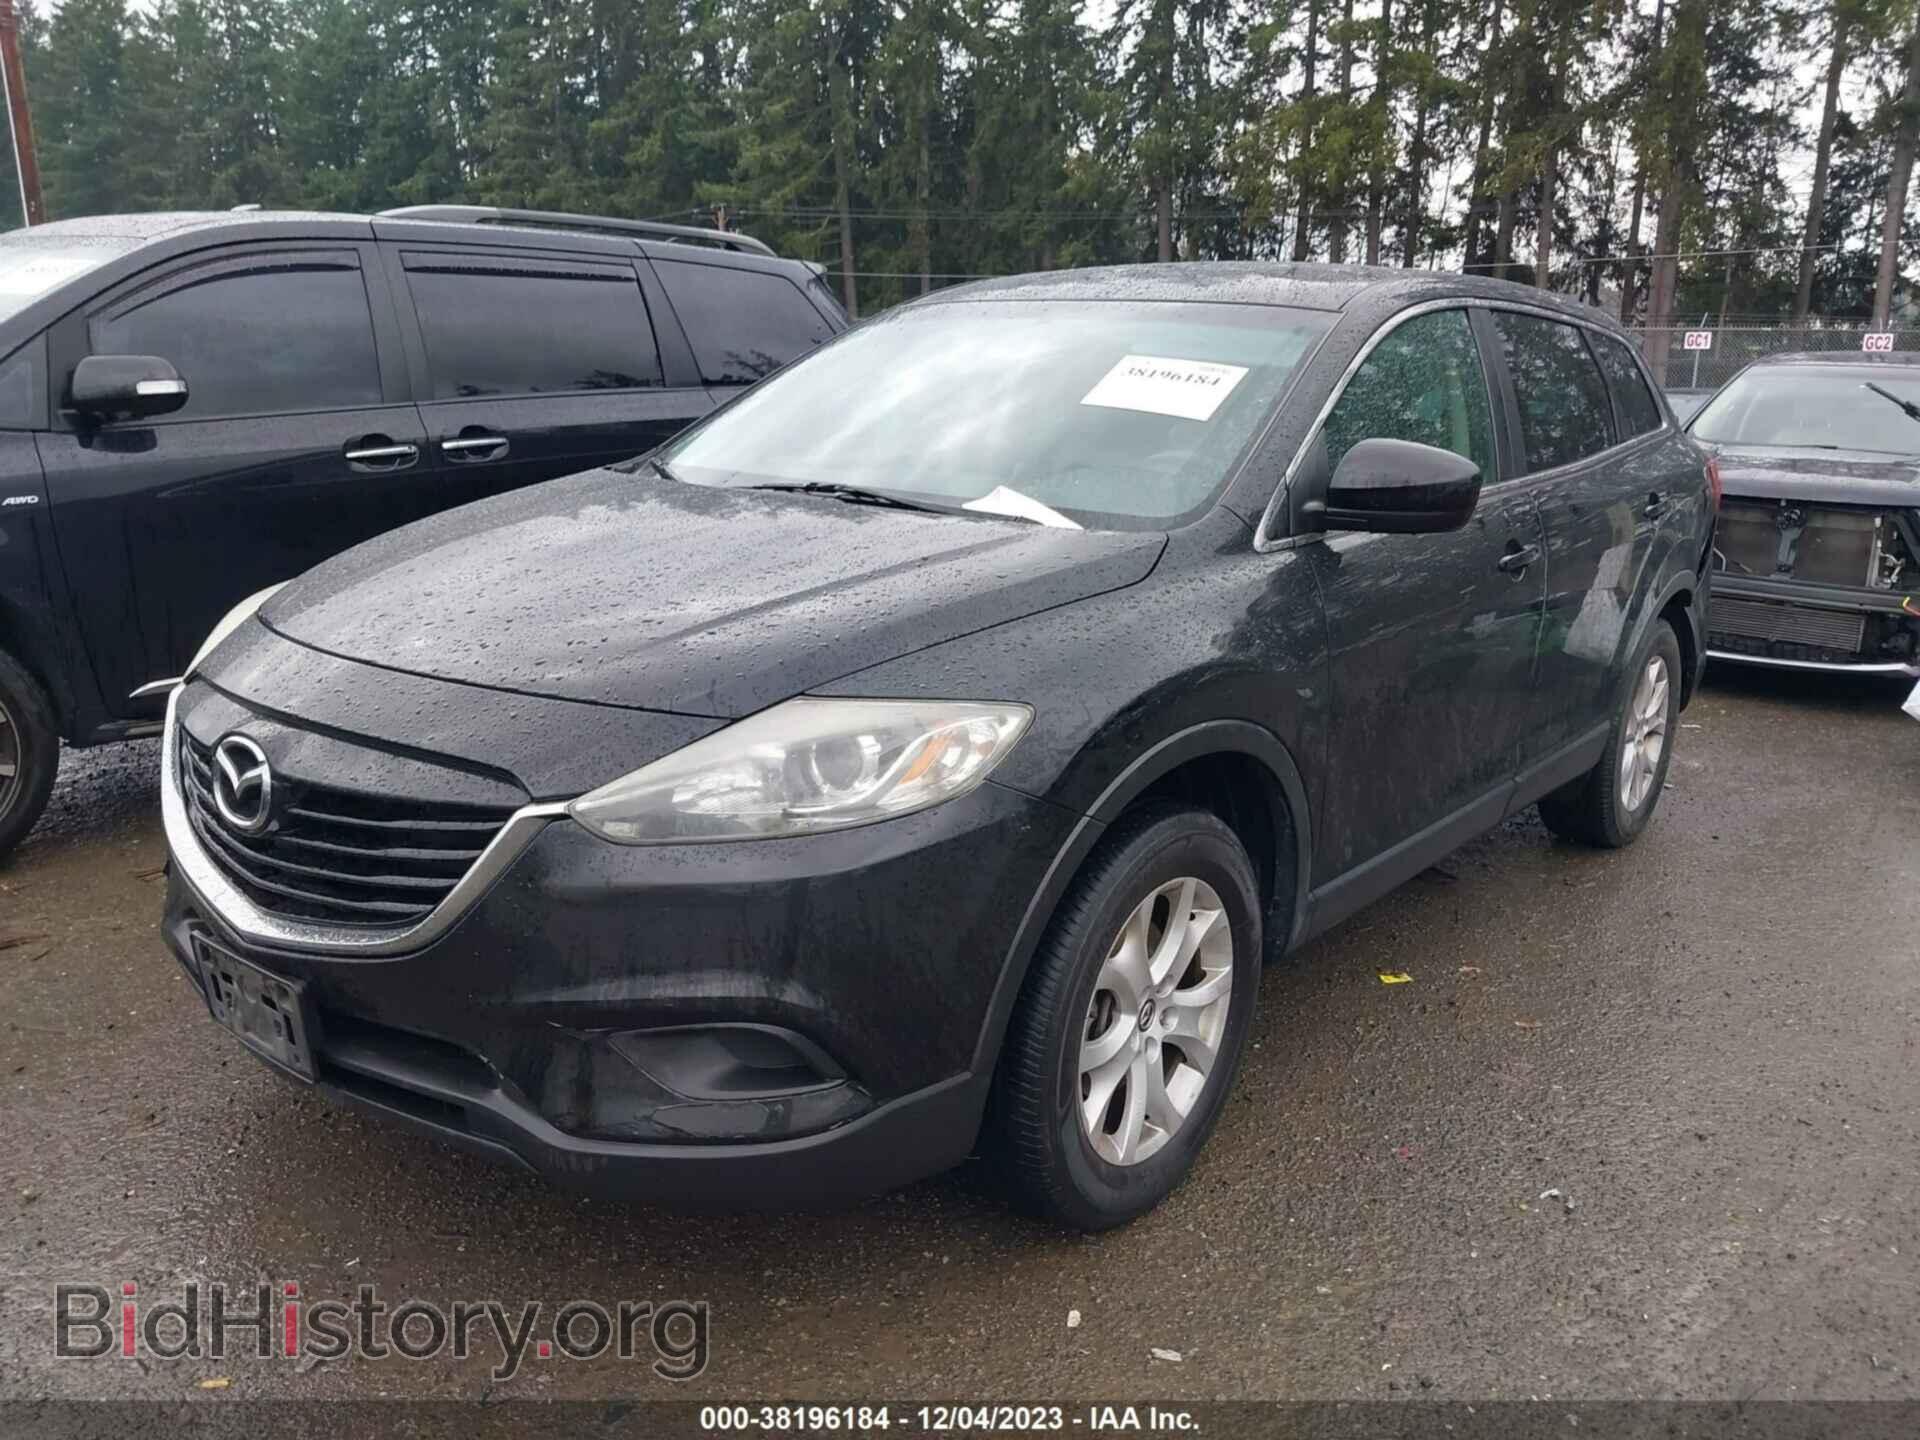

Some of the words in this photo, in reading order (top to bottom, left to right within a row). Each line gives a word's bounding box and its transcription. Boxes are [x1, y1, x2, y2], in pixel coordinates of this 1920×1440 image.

[1687, 334, 1709, 347] GC1
[1865, 335, 1891, 350] GC2
[1, 495, 39, 506] AWD
